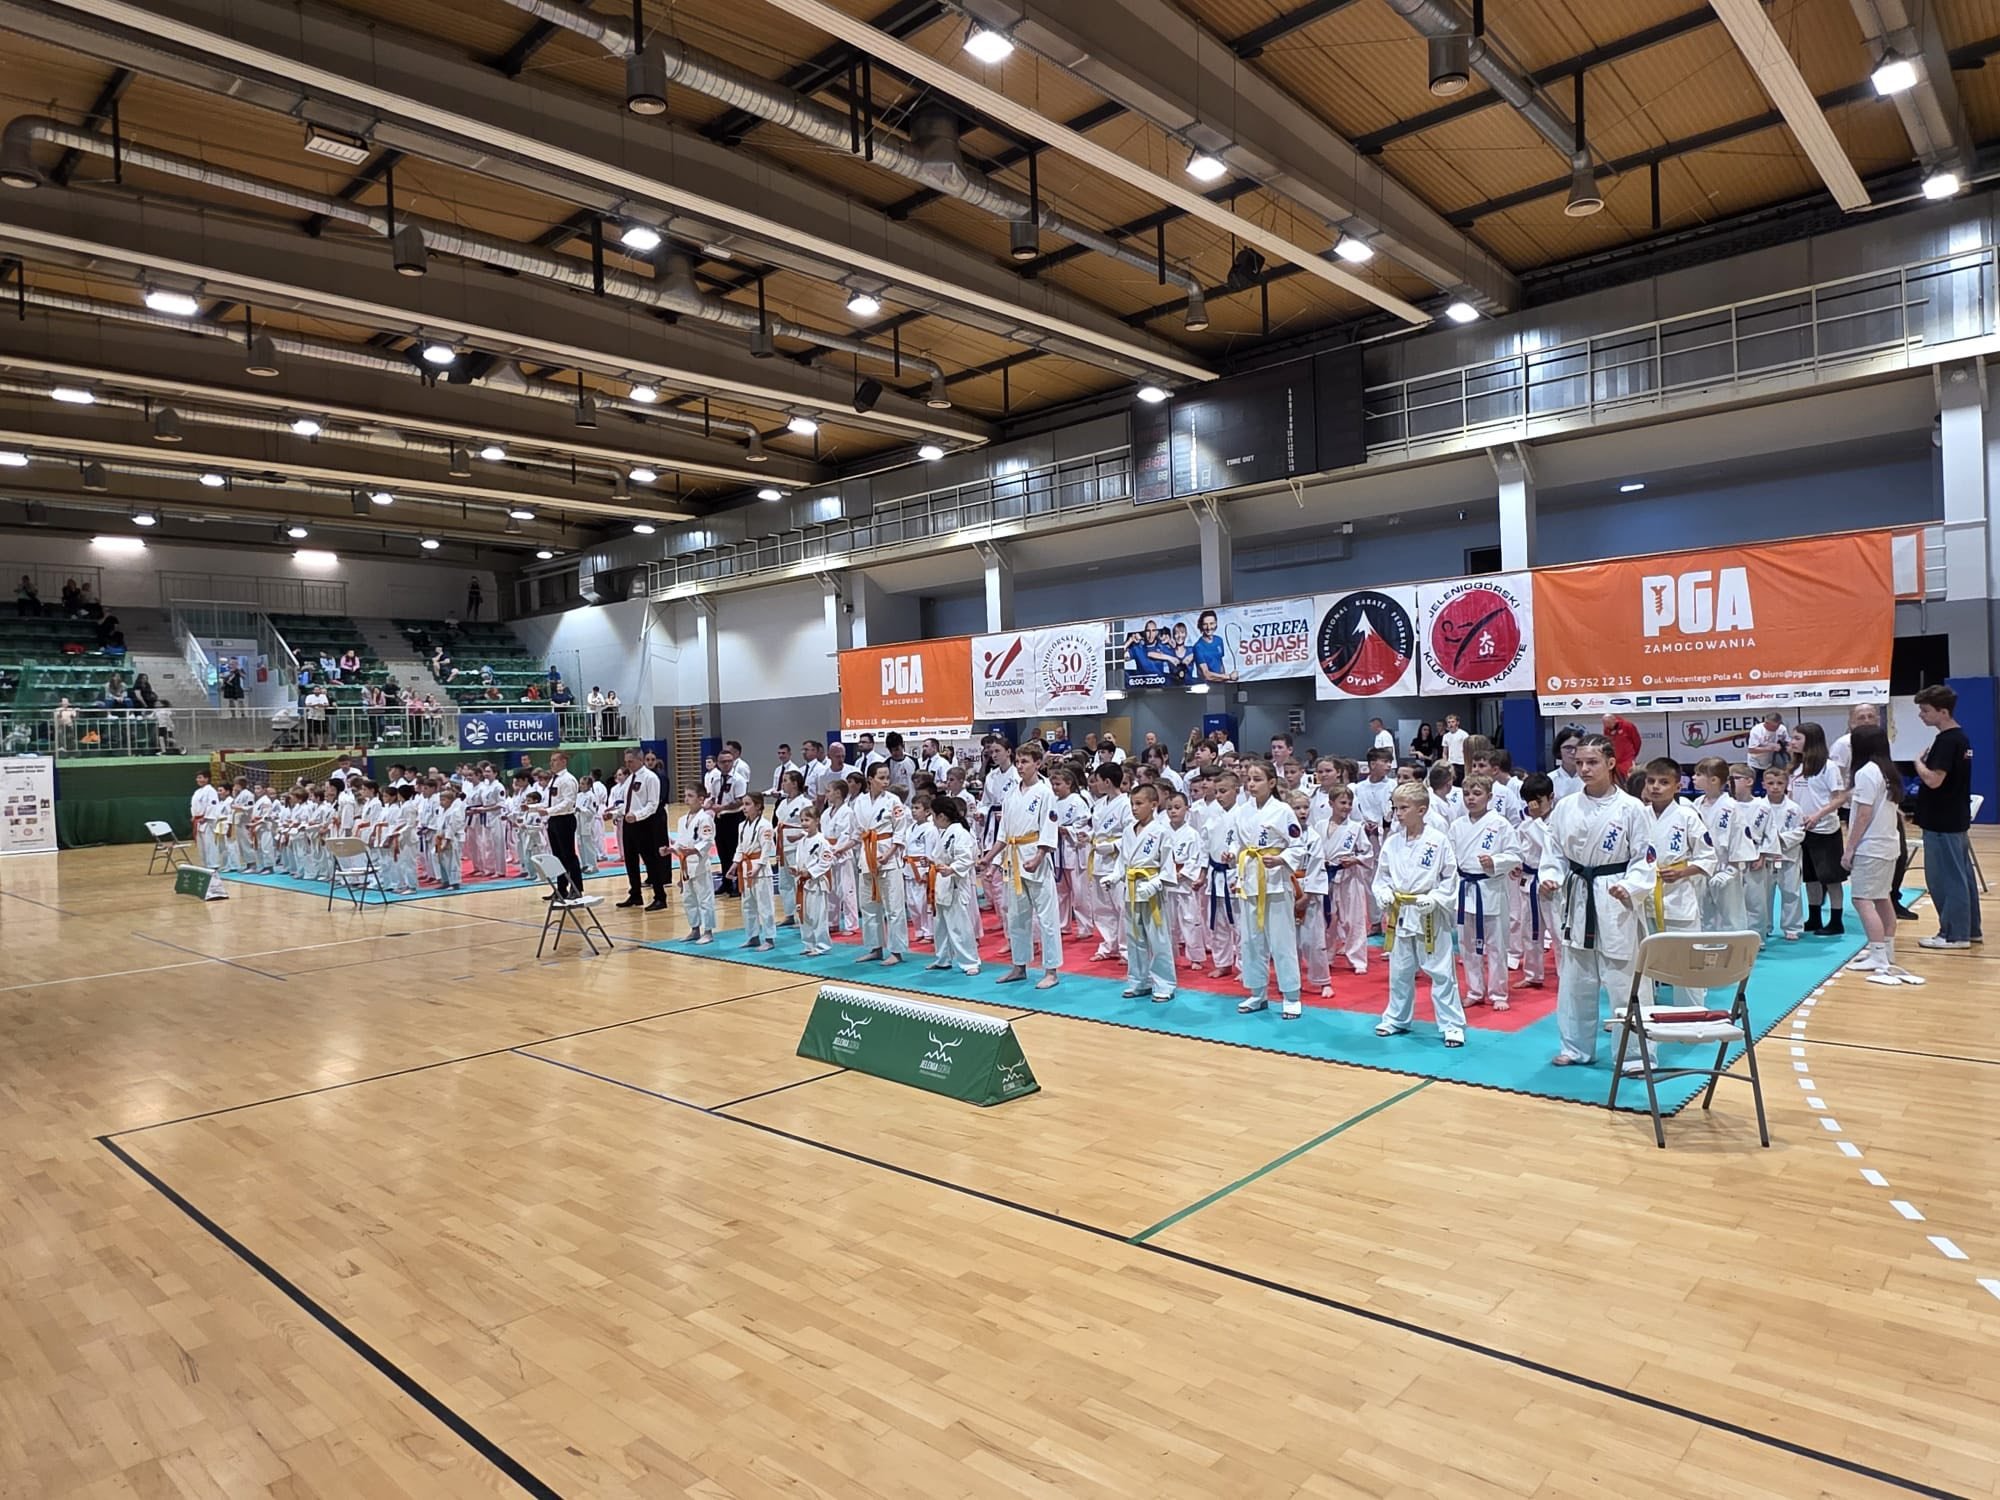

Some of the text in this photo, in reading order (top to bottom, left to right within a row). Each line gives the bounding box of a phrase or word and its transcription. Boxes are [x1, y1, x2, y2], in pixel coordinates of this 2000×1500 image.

[1355, 599, 1387, 610] KARATE
[1428, 581, 1520, 618] JELENIOGÓRSKI
[1641, 566, 1754, 637] PGA
[1252, 618, 1309, 639] STREFA
[1239, 633, 1309, 656] SQUASH
[1644, 637, 1756, 654] ZAMOCOWANIA
[1057, 653, 1082, 674] 30
[1245, 649, 1309, 666] & FITNESS
[881, 654, 924, 696] PGA
[1423, 643, 1528, 690] KLUB OYAMA KARATE
[1346, 673, 1384, 687] OYAMA
[1563, 676, 1632, 688] 75 752 12 15
[1745, 692, 1774, 700] fischer
[505, 719, 543, 729] TERMY
[1714, 716, 1765, 734] JELEN
[495, 731, 554, 743] CIEPLICKIE
